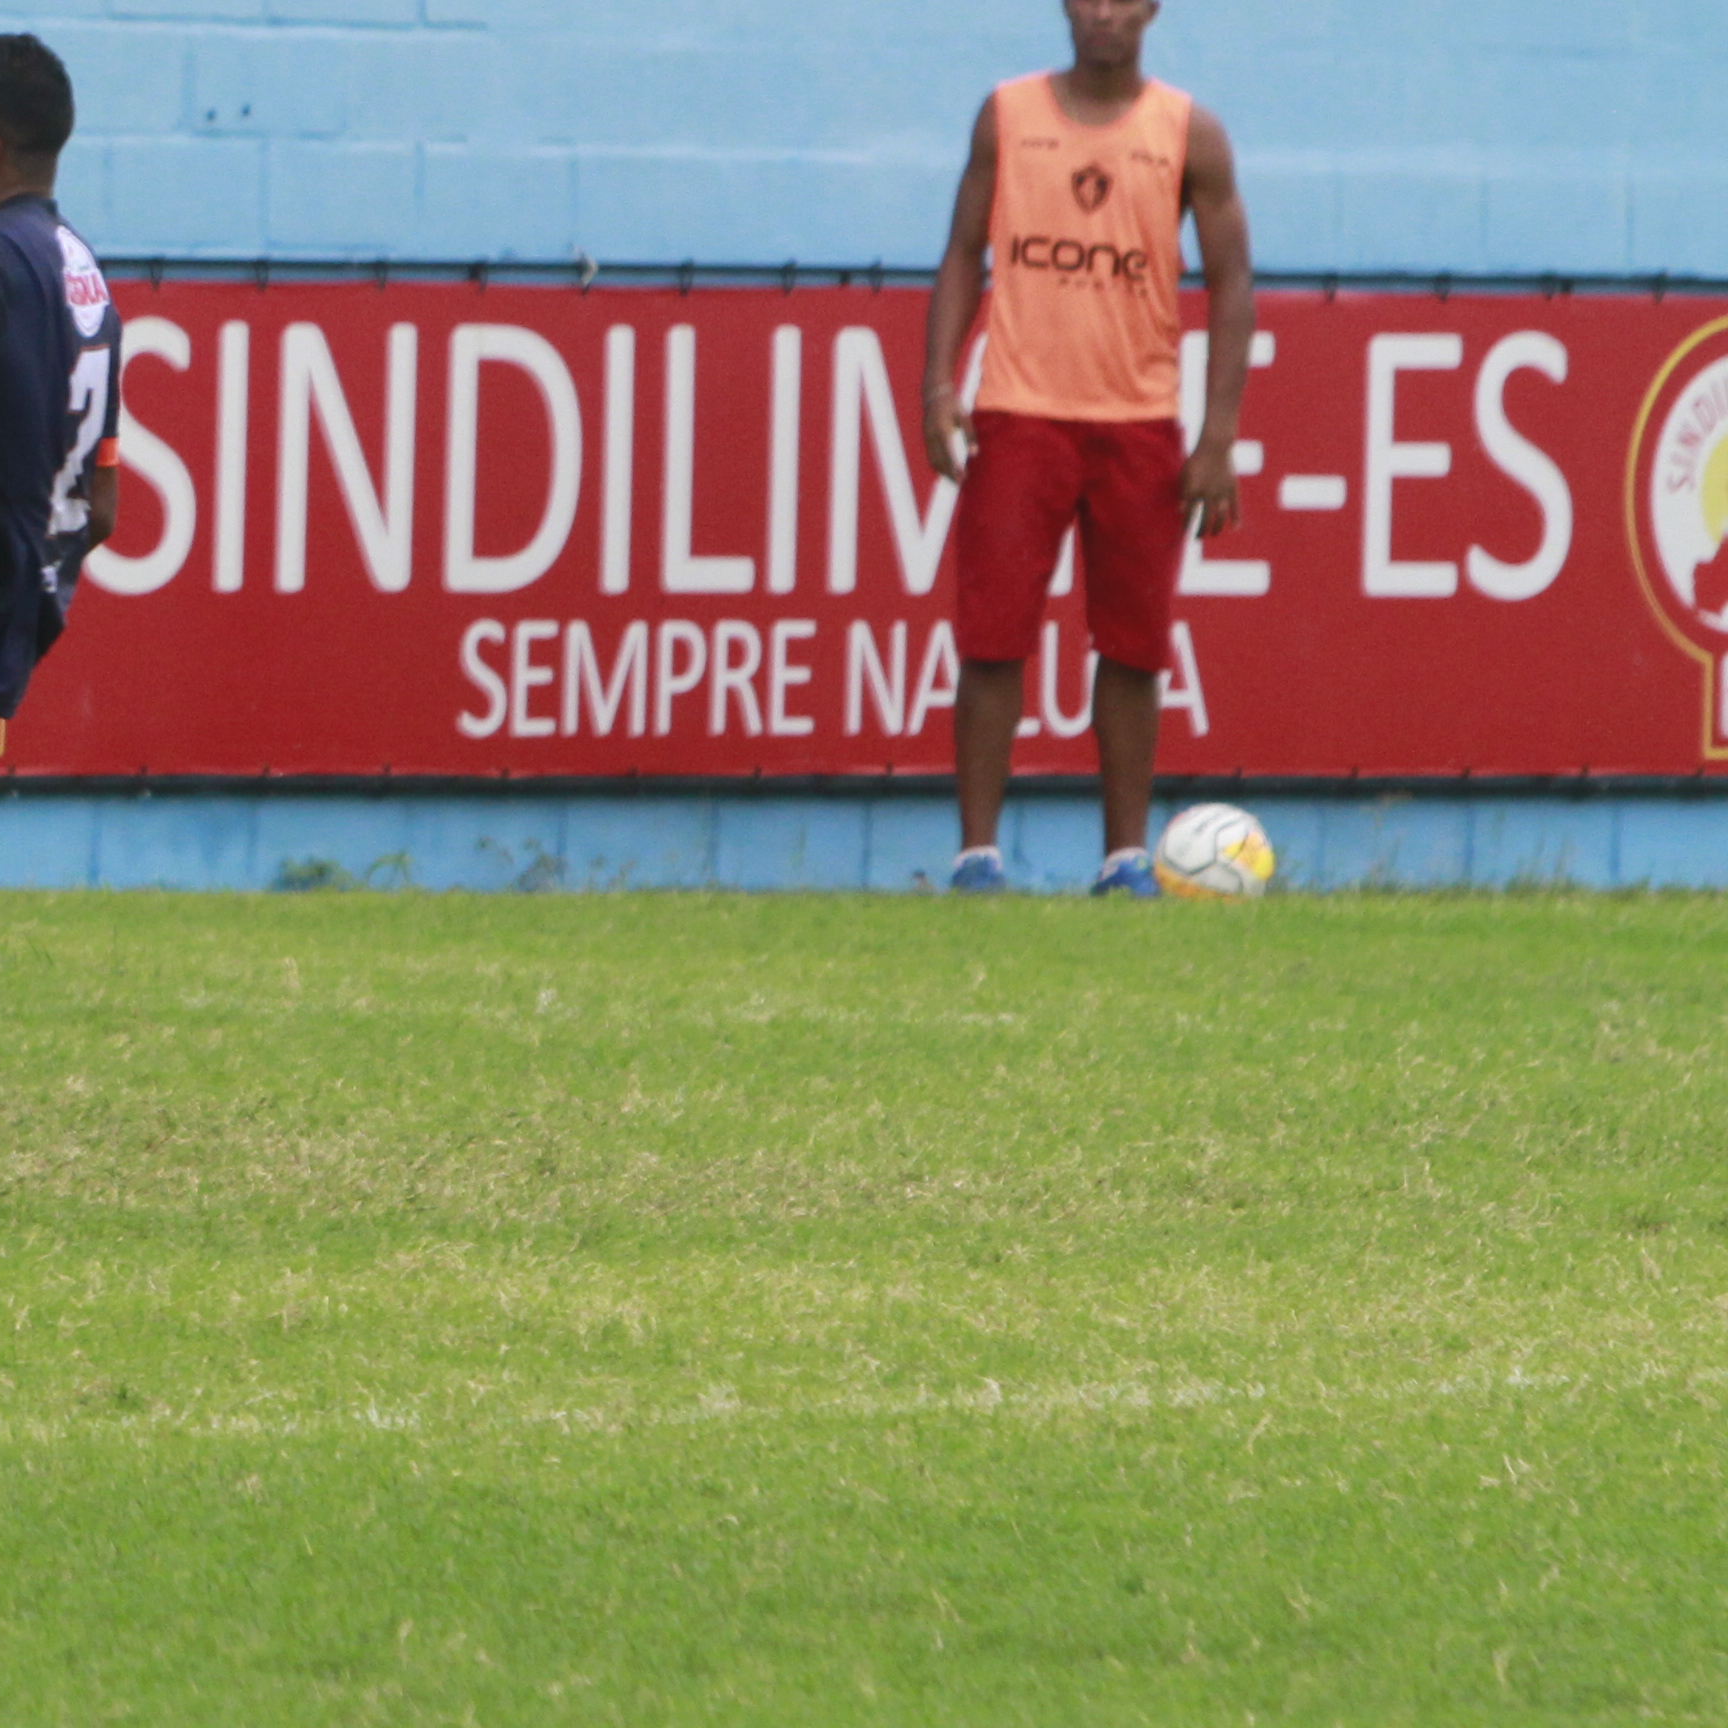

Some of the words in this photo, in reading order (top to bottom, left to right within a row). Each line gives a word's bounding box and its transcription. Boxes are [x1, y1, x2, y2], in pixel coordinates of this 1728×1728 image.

[47, 344, 111, 537] 2
[82, 316, 1574, 601] SINDILIME-ES
[456, 618, 817, 739] SEMPRE
[844, 619, 961, 737] NA
[1015, 619, 1210, 739] UA
